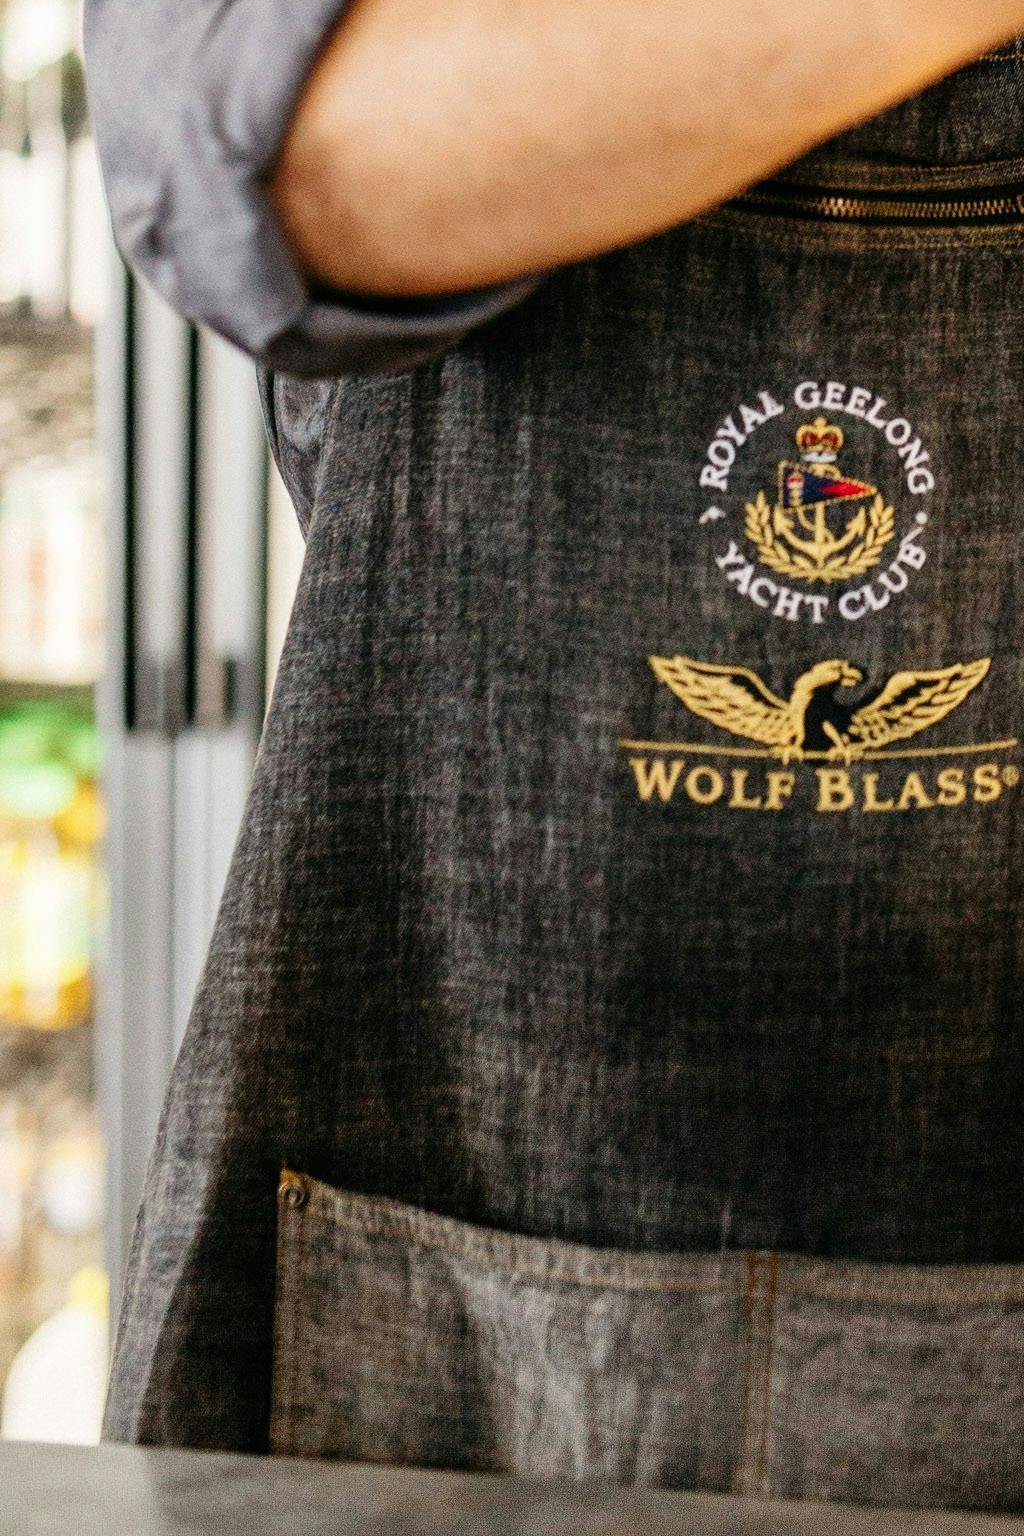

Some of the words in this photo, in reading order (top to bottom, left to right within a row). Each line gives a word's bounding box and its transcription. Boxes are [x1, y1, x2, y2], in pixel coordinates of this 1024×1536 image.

[700, 391, 784, 491] ROYAL
[794, 381, 935, 494] GEELONG
[715, 541, 829, 624] YACHT
[838, 543, 926, 621] CLUB
[629, 758, 796, 811] WOLF
